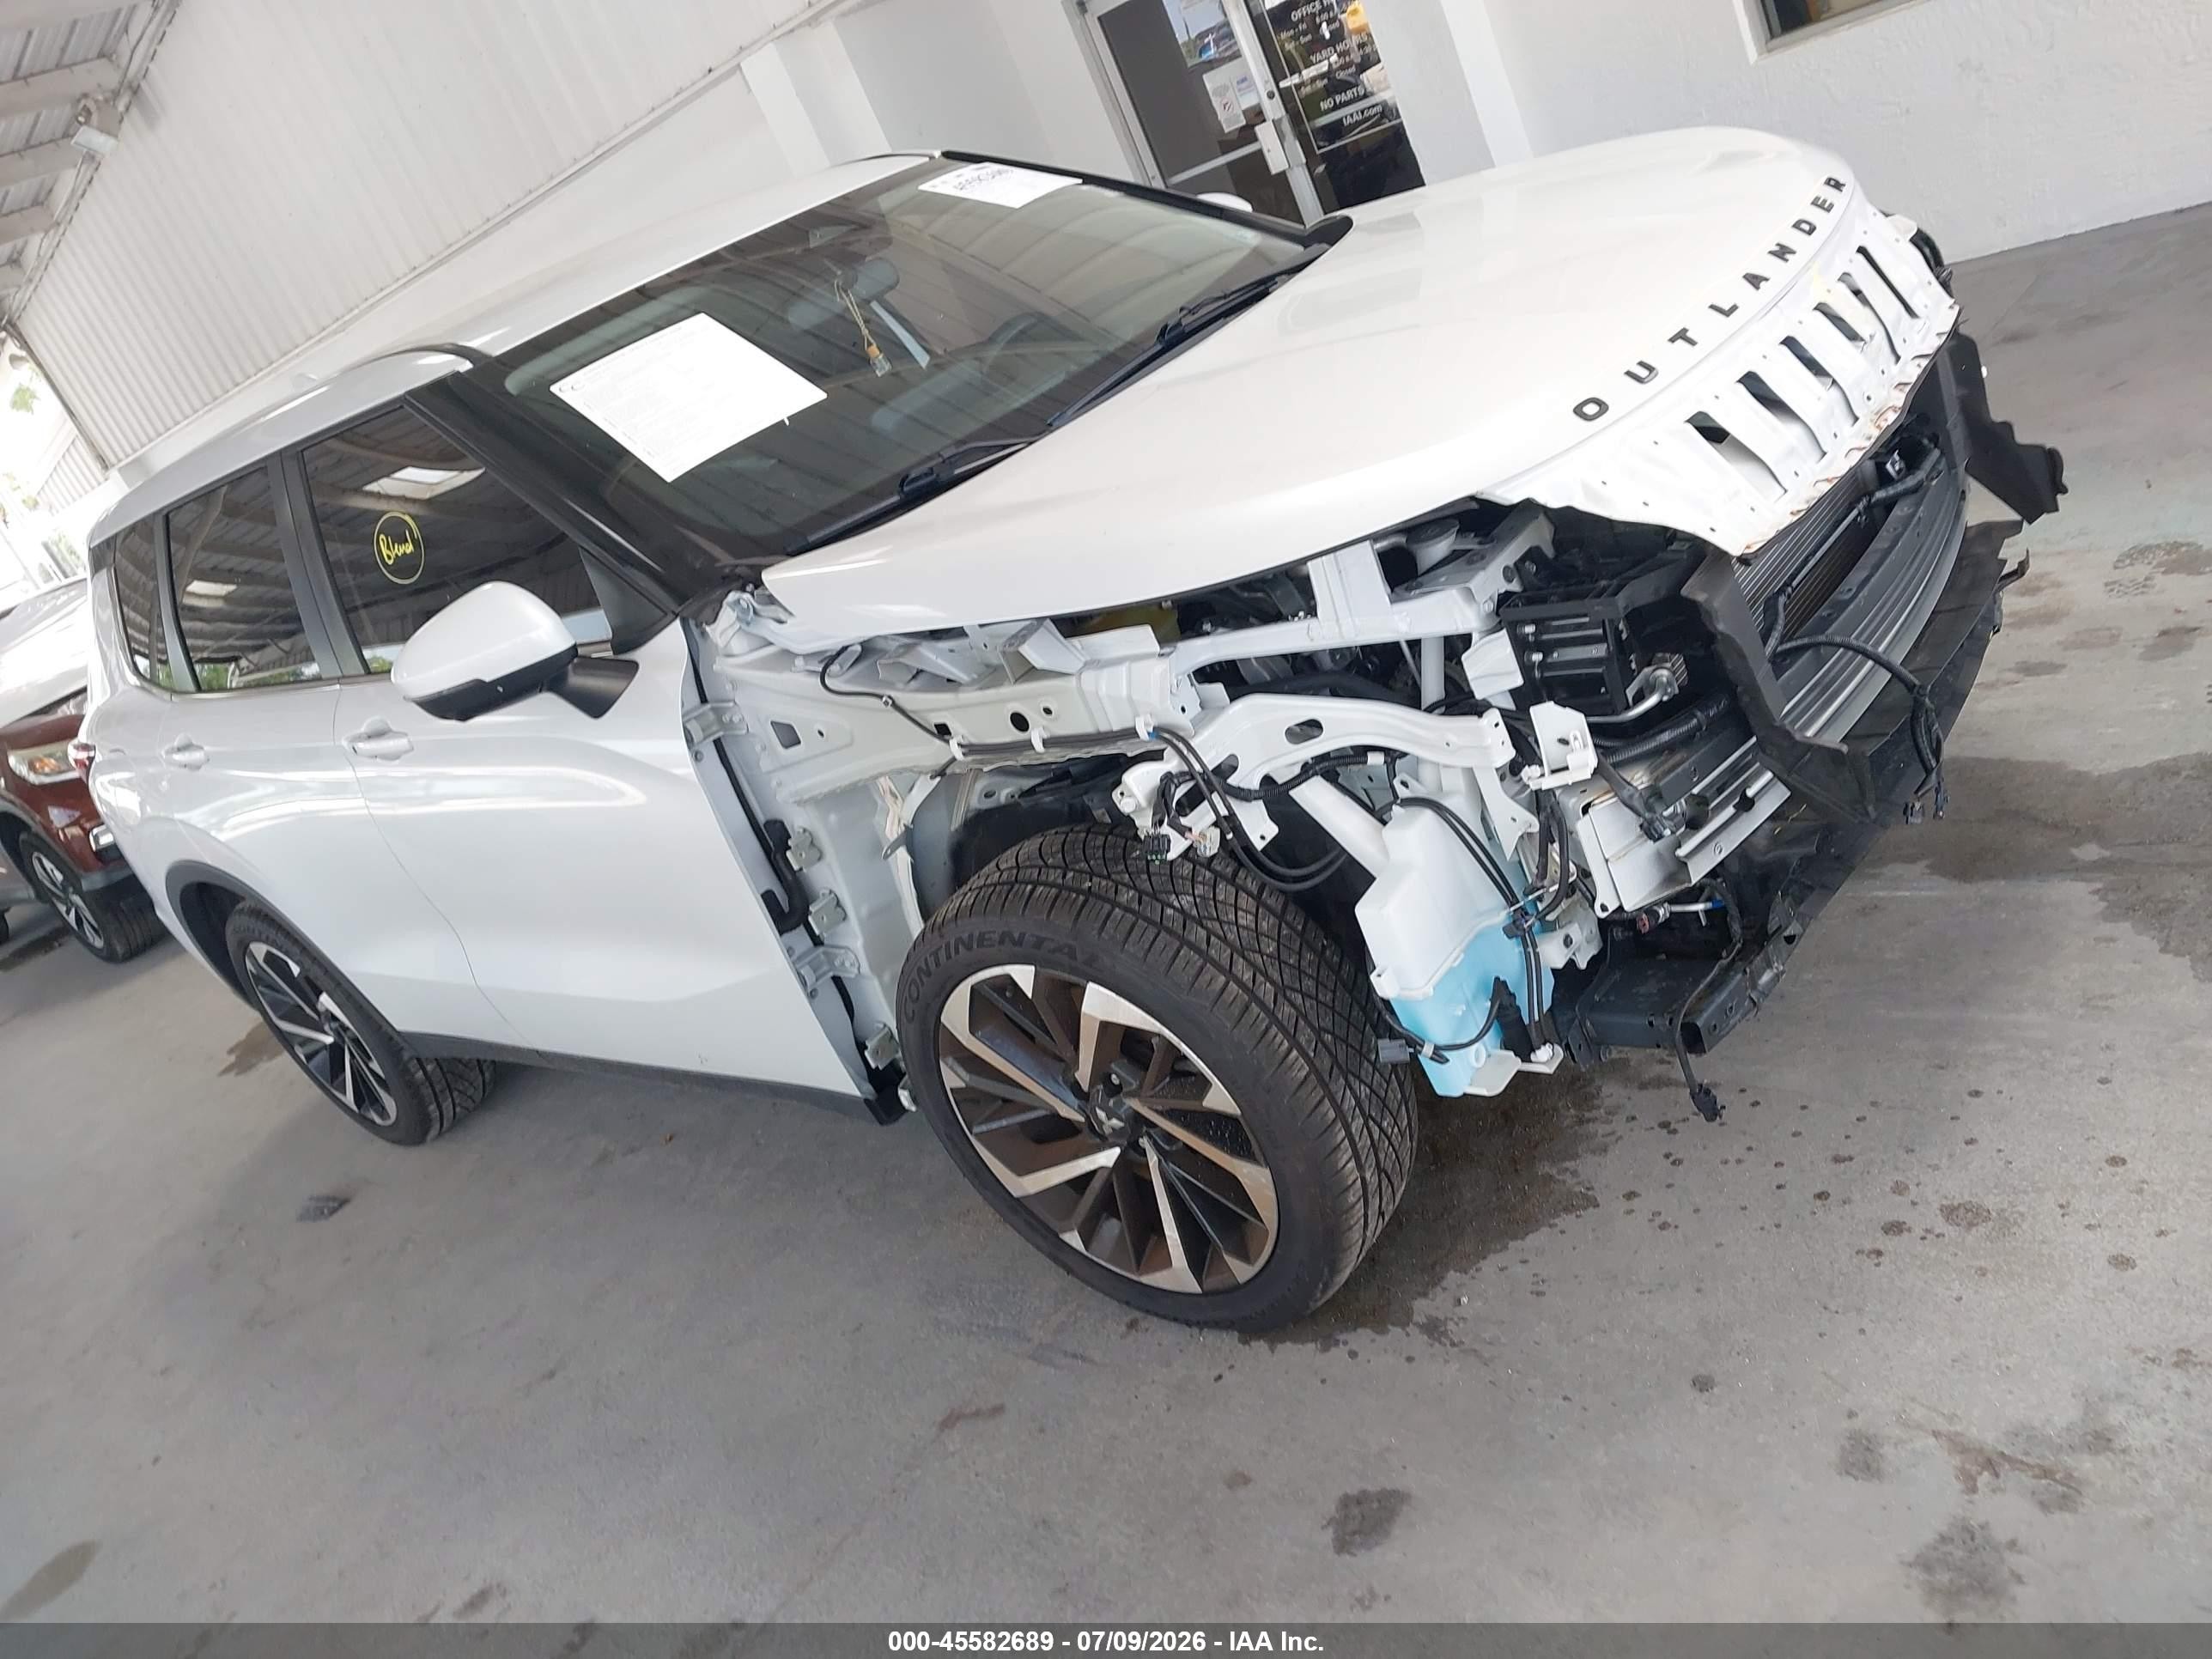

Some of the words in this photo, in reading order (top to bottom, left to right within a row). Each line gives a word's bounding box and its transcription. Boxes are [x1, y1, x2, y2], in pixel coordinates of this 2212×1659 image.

[1291, 0, 1322, 21] OFFICE
[1310, 46, 1334, 64] YARD
[1320, 97, 1334, 112] NO
[1335, 85, 1365, 104] PARTS
[1343, 104, 1382, 126] IAAI.com
[1573, 175, 1846, 422] OUTLANDER
